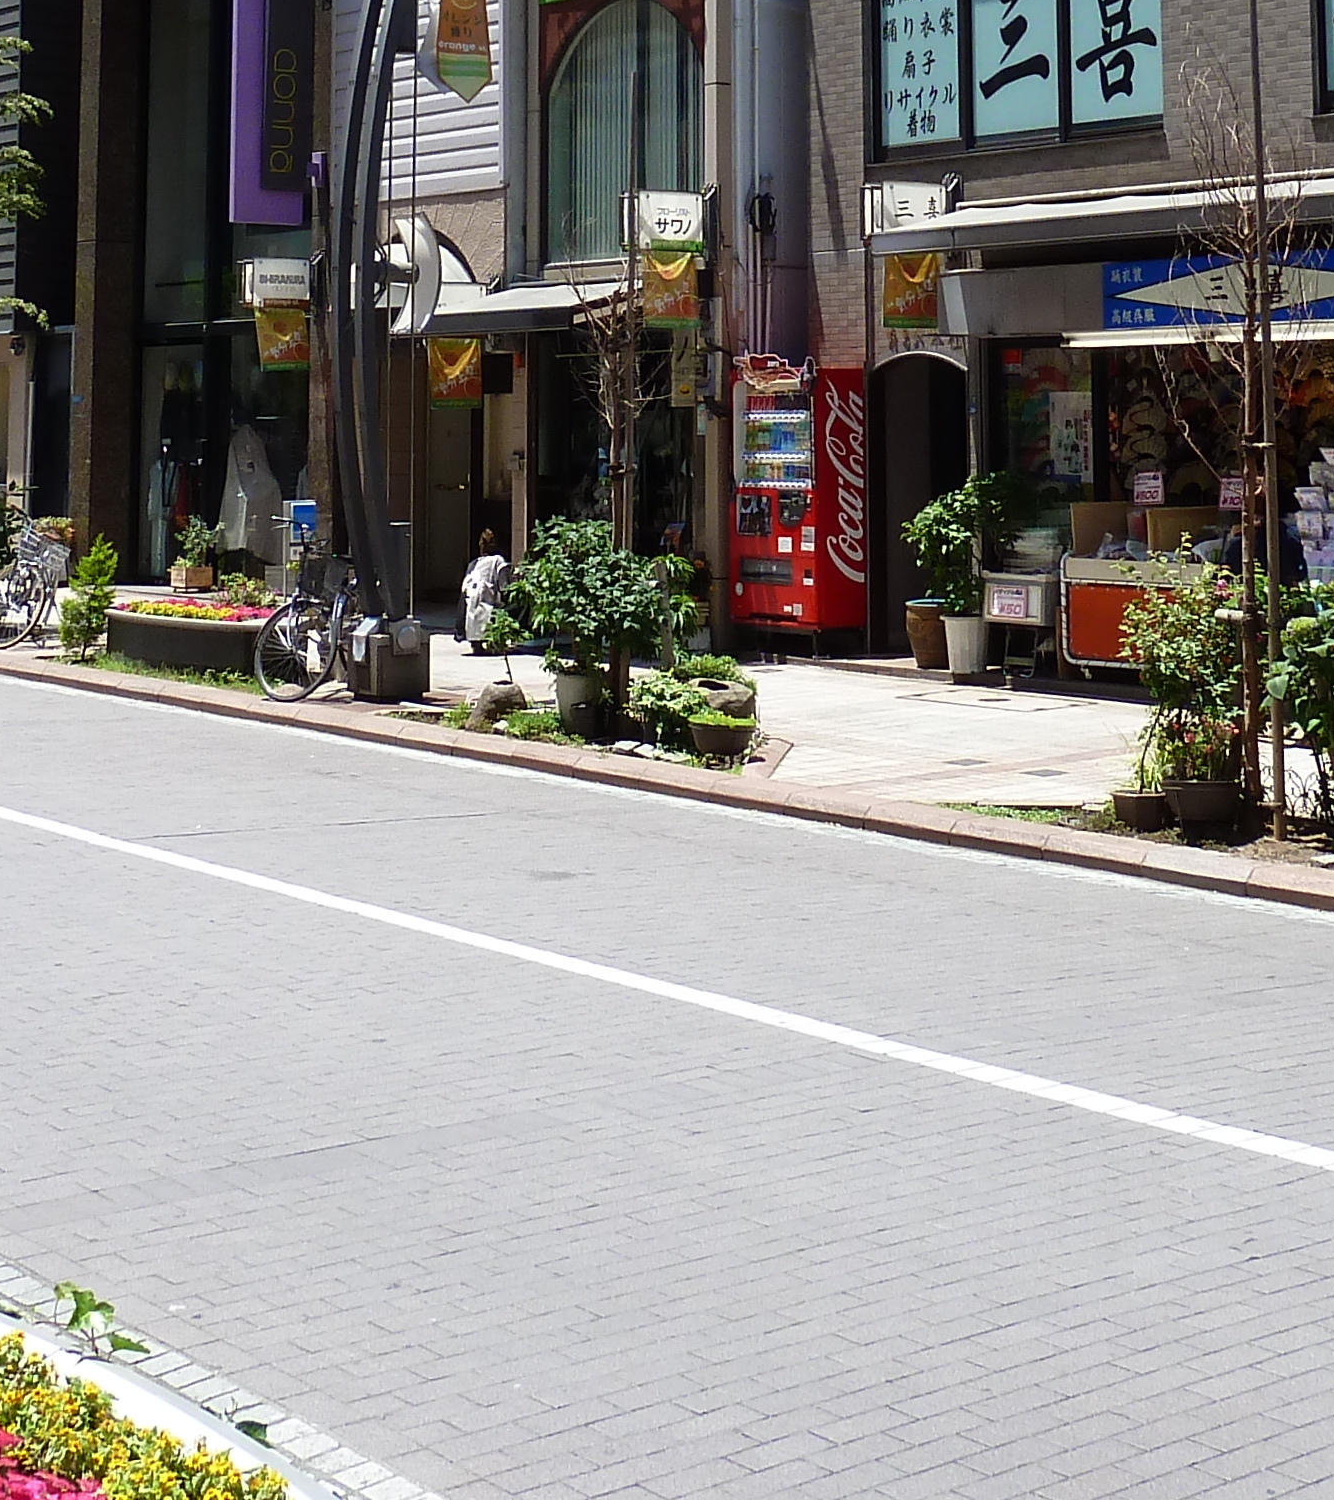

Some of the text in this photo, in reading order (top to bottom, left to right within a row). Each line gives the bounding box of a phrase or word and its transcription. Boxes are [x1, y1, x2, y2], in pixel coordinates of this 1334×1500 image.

[438, 40, 476, 53] orange
[902, 50, 936, 80] 扇子
[269, 48, 298, 173] donna
[883, 83, 958, 115] リサイクル
[906, 109, 937, 139] 着物
[894, 196, 940, 219] 三喜
[654, 217, 692, 235] サワノ
